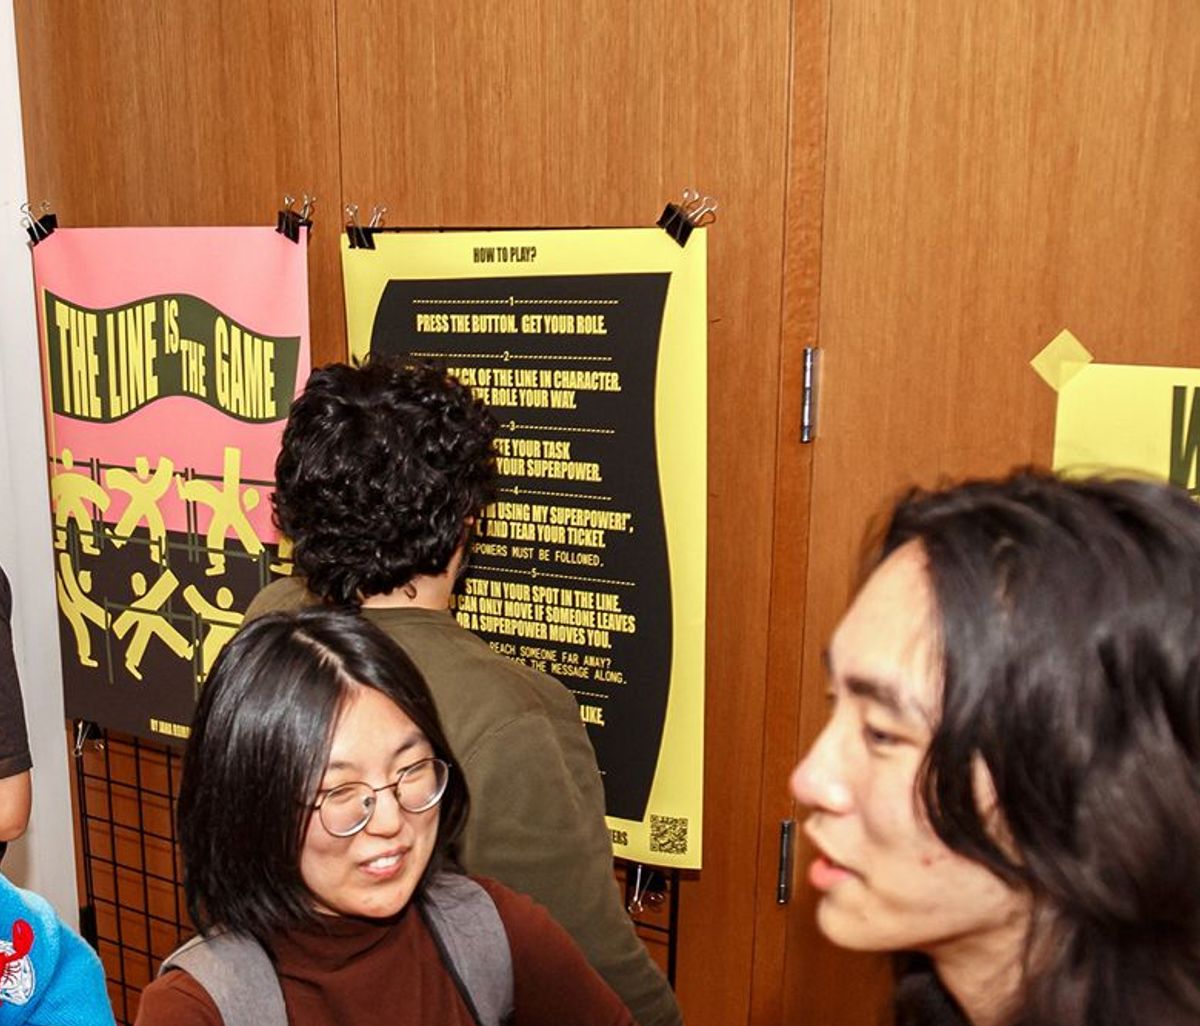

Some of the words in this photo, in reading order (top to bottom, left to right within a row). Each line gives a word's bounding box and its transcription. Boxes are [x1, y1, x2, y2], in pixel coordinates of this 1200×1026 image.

[473, 246, 495, 263] HOW
[497, 246, 508, 263] TO
[510, 245, 538, 263] PLAY?
[416, 313, 449, 333] PRESS
[450, 314, 470, 333] THE
[472, 314, 518, 333] BUTTON.
[521, 314, 543, 334] GET
[544, 315, 574, 334] YOUR
[576, 315, 608, 335] ROLE.
[55, 300, 102, 419] THE
[106, 301, 158, 419] LINE
[163, 298, 179, 354] IS
[180, 338, 207, 397] THE
[215, 316, 277, 419] GAME
[478, 368, 493, 387] OF
[493, 369, 514, 388] THE
[515, 369, 539, 388] LINE
[540, 370, 551, 388] IN
[553, 370, 621, 392] CHARACTER.
[491, 388, 518, 407] ROLE
[519, 389, 548, 408] YOUR
[550, 390, 577, 410] WAY.
[512, 439, 541, 458] YOUR
[542, 441, 571, 460] TASK
[496, 457, 525, 476] YOUR
[527, 459, 602, 482] SUPERPOWER.
[498, 502, 530, 521] USING
[532, 504, 548, 523] MY
[487, 520, 508, 538] AND
[509, 522, 536, 541] TEAR
[537, 525, 566, 544] YOUR
[567, 527, 606, 548] TICKET.
[512, 546, 534, 559] MUST
[539, 549, 550, 562] BE
[555, 551, 604, 567] FOLLOWED.
[465, 578, 489, 596] STAY
[490, 580, 502, 597] IN
[503, 582, 531, 601] YOUR
[532, 585, 559, 604] SPOT
[561, 588, 572, 606] IN
[574, 590, 594, 609] THE
[595, 593, 621, 612] LINE.
[457, 595, 478, 612] CAN
[479, 597, 503, 617] ONLY
[504, 600, 533, 620] MOVE
[534, 604, 545, 622] IF
[546, 606, 596, 628] SOMEONE
[597, 612, 636, 633] LEAVES
[456, 612, 470, 629] OR
[471, 614, 479, 631] A
[480, 615, 548, 640] SUPERPOWER
[549, 624, 586, 646] MOVES
[587, 629, 612, 649] YOU.
[520, 645, 557, 661] SOMEONE
[561, 651, 579, 664] FAR
[583, 655, 612, 669] AWAY?
[532, 660, 547, 672] THE
[552, 662, 589, 679] MESSAGE
[594, 670, 627, 685] ALONG.
